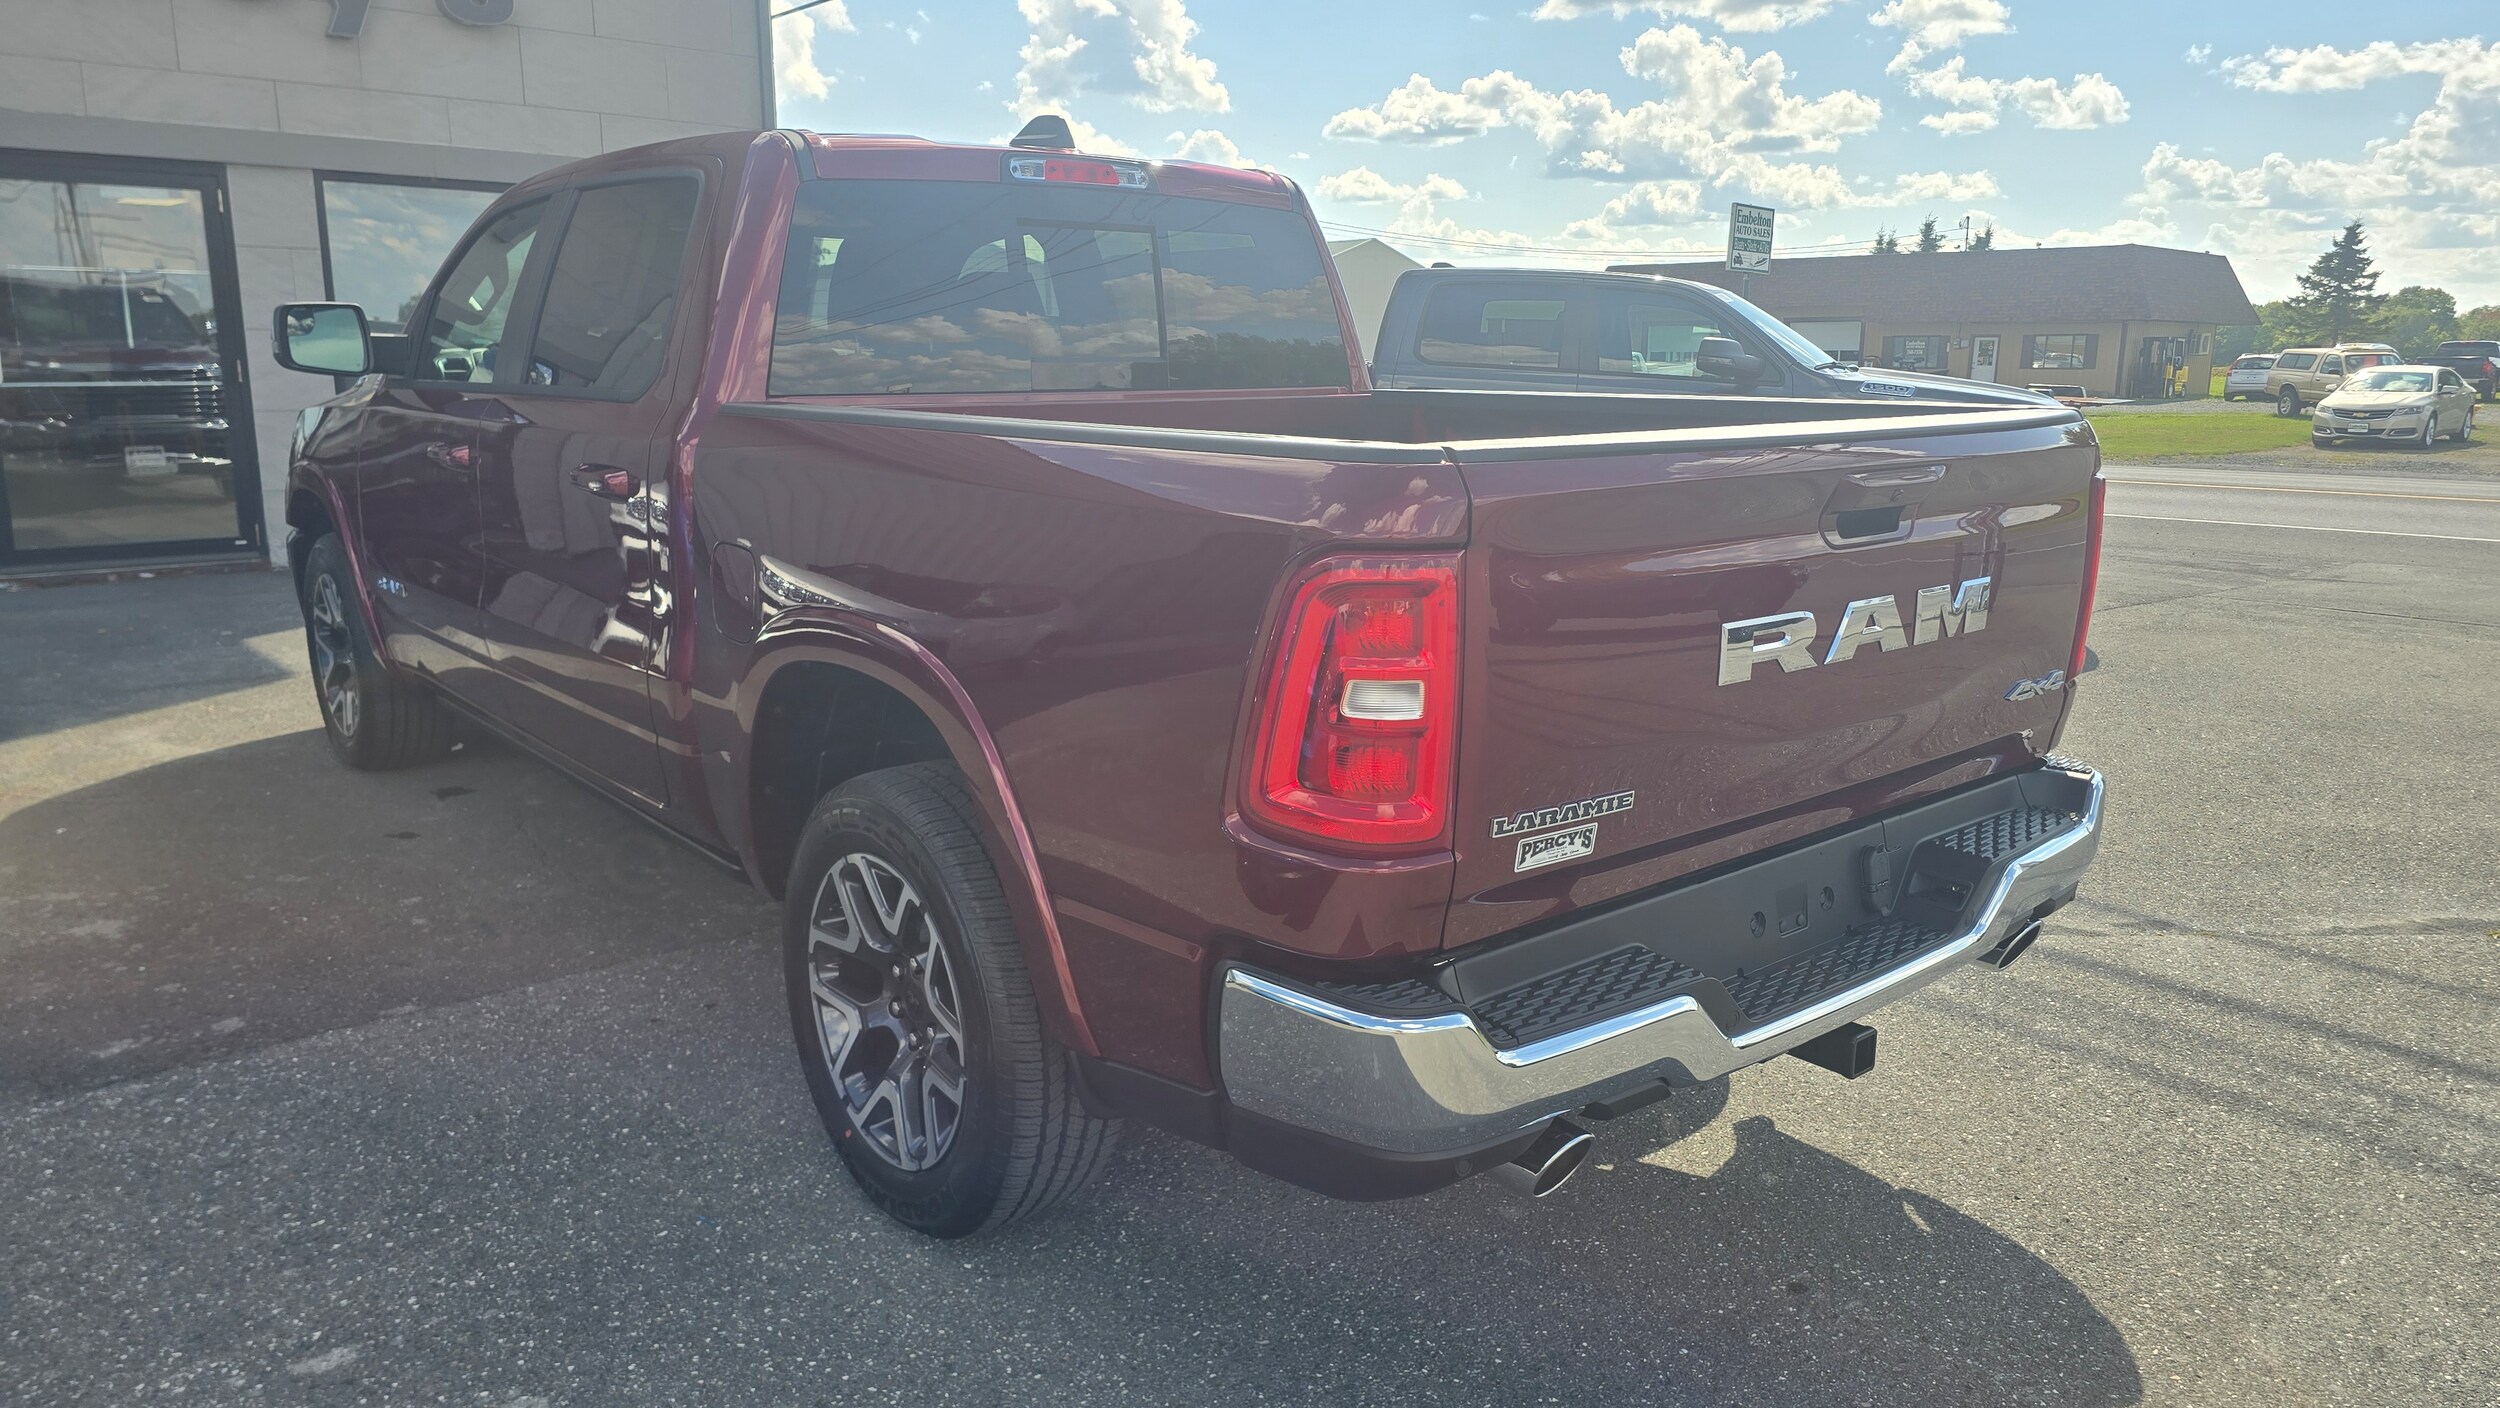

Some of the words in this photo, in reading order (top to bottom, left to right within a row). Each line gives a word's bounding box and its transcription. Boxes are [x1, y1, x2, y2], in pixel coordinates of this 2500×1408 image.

[1736, 209, 1771, 228] Embelton
[1736, 225, 1752, 236] AUTO
[1752, 227, 1771, 239] SALES
[1718, 576, 1991, 686] RAM
[1490, 789, 1635, 838] LARAMIE
[1519, 827, 1594, 866] PERCY'S
